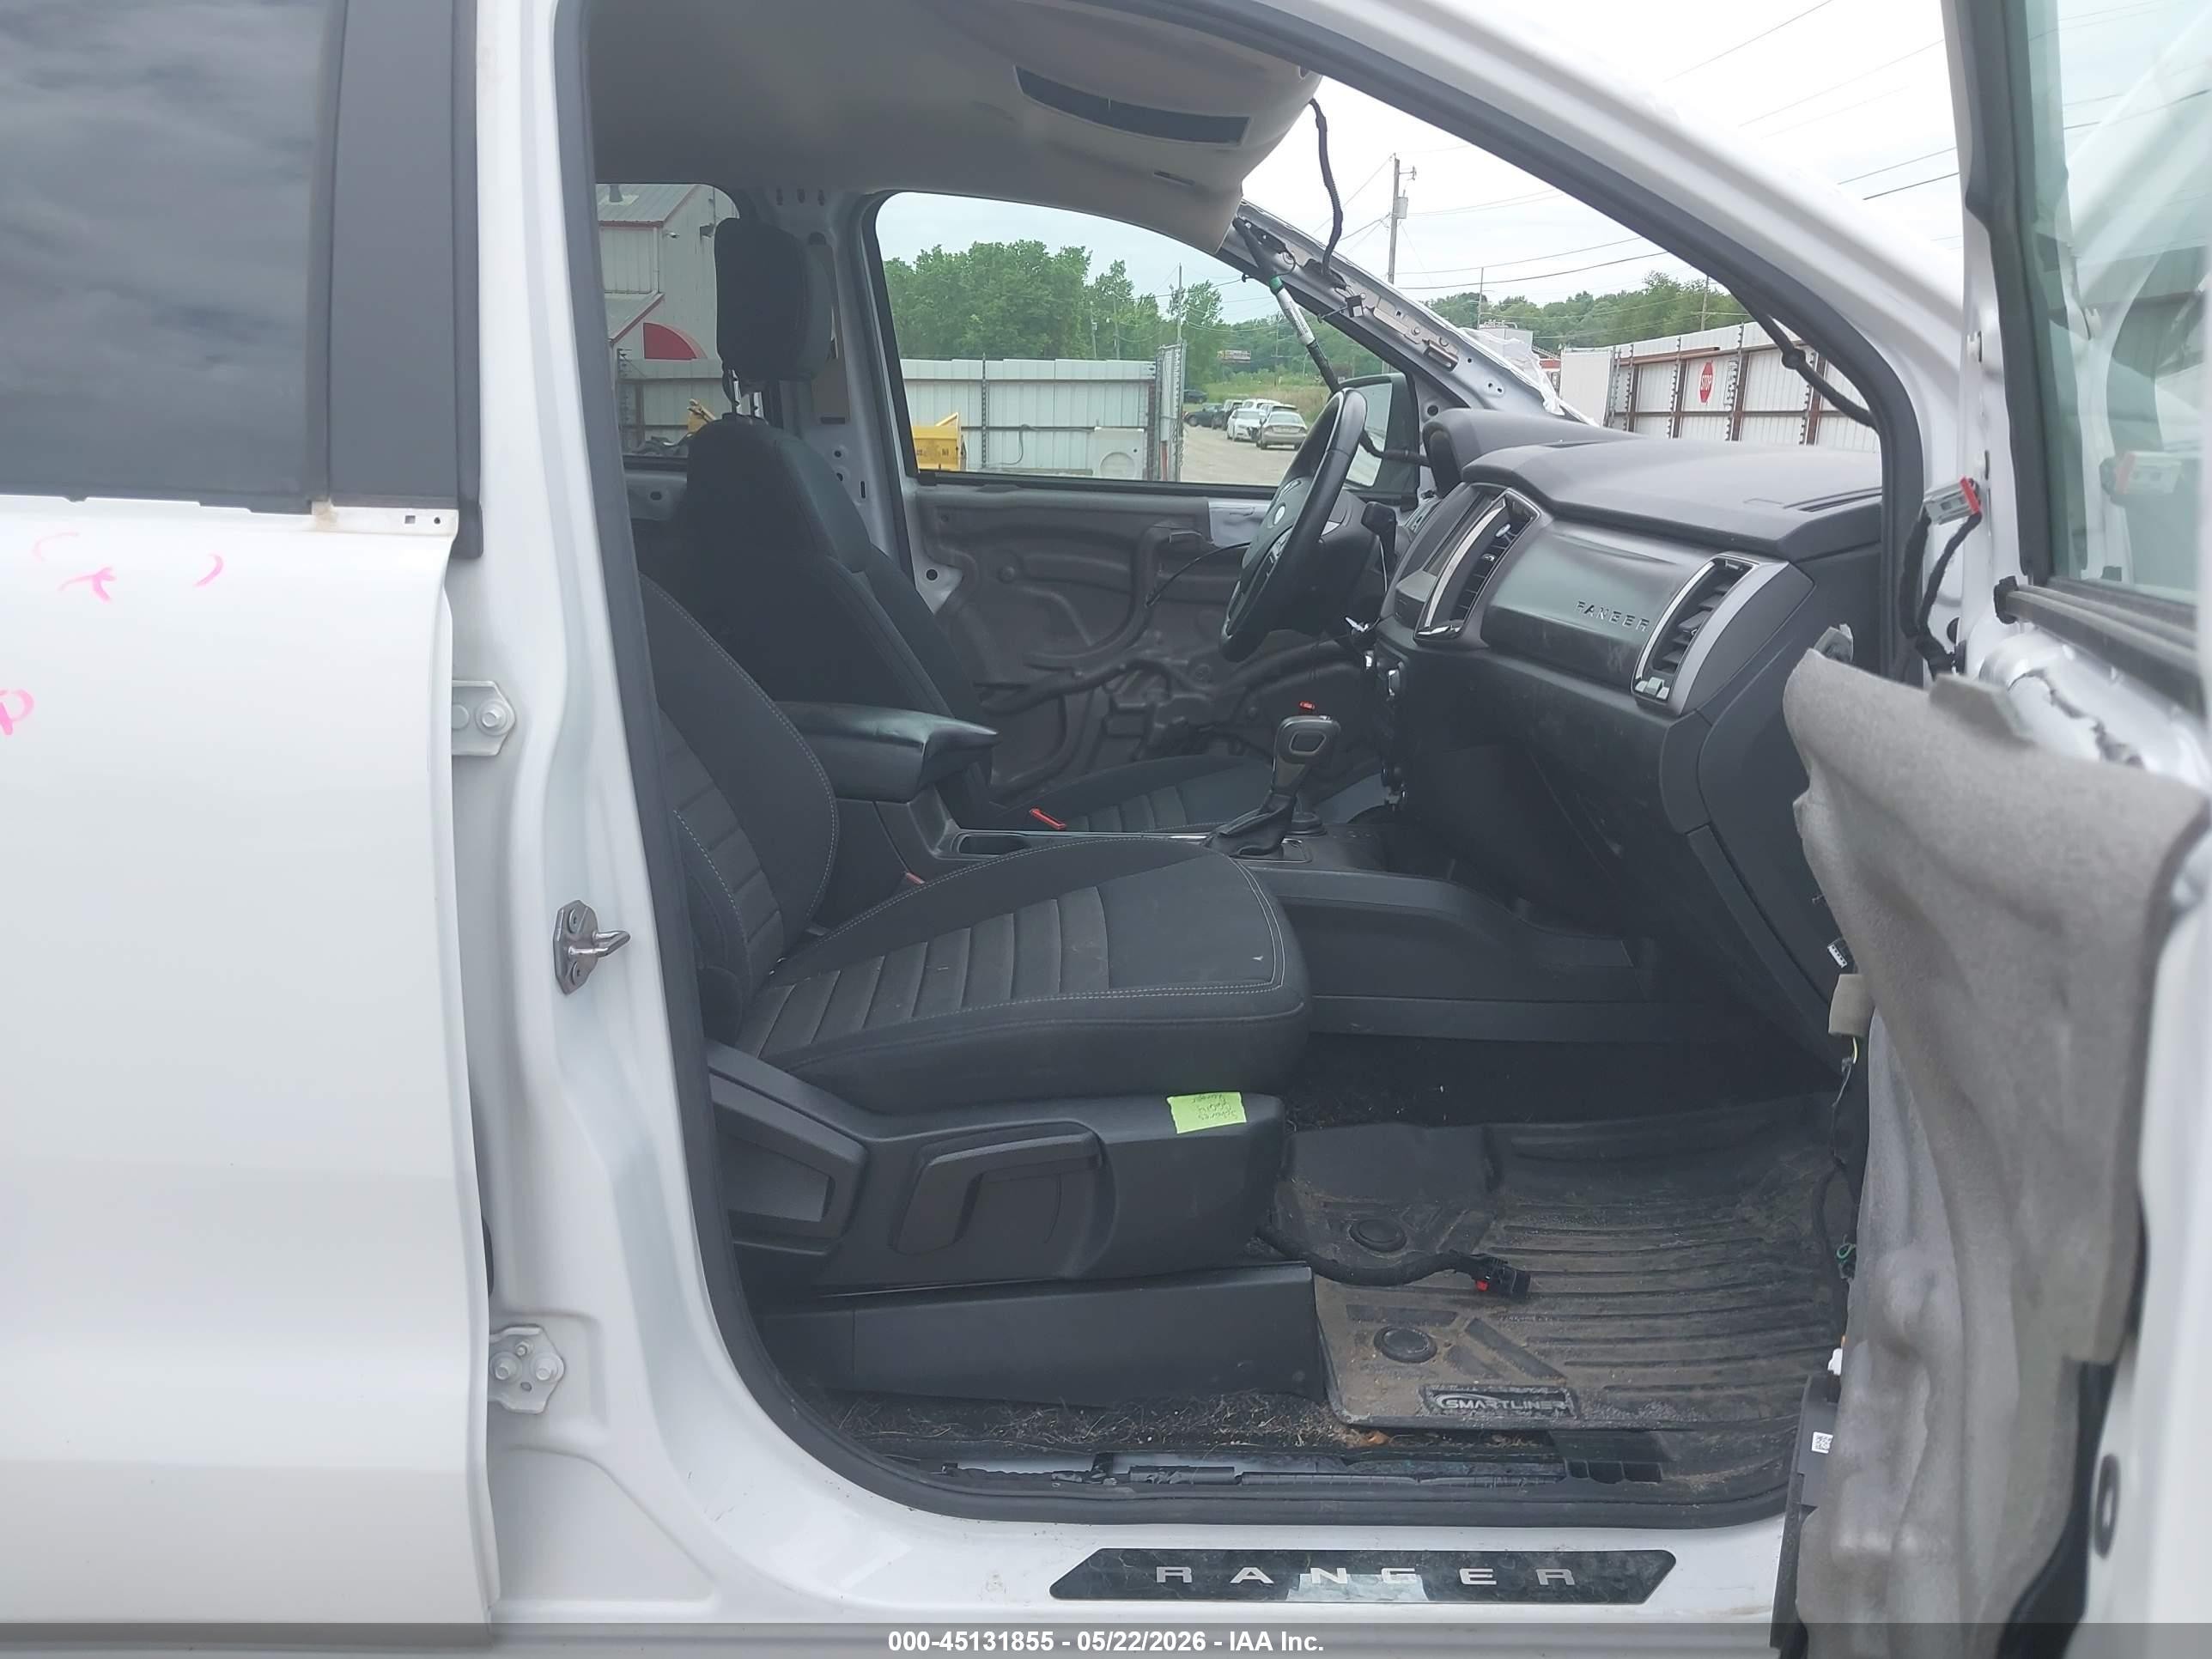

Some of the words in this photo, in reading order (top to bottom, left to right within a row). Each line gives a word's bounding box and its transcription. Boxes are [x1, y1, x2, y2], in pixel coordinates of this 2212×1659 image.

[1701, 374, 1713, 392] STOP
[1444, 1398, 1568, 1411] SMARTLINER
[1156, 1566, 1576, 1586] RANGER
